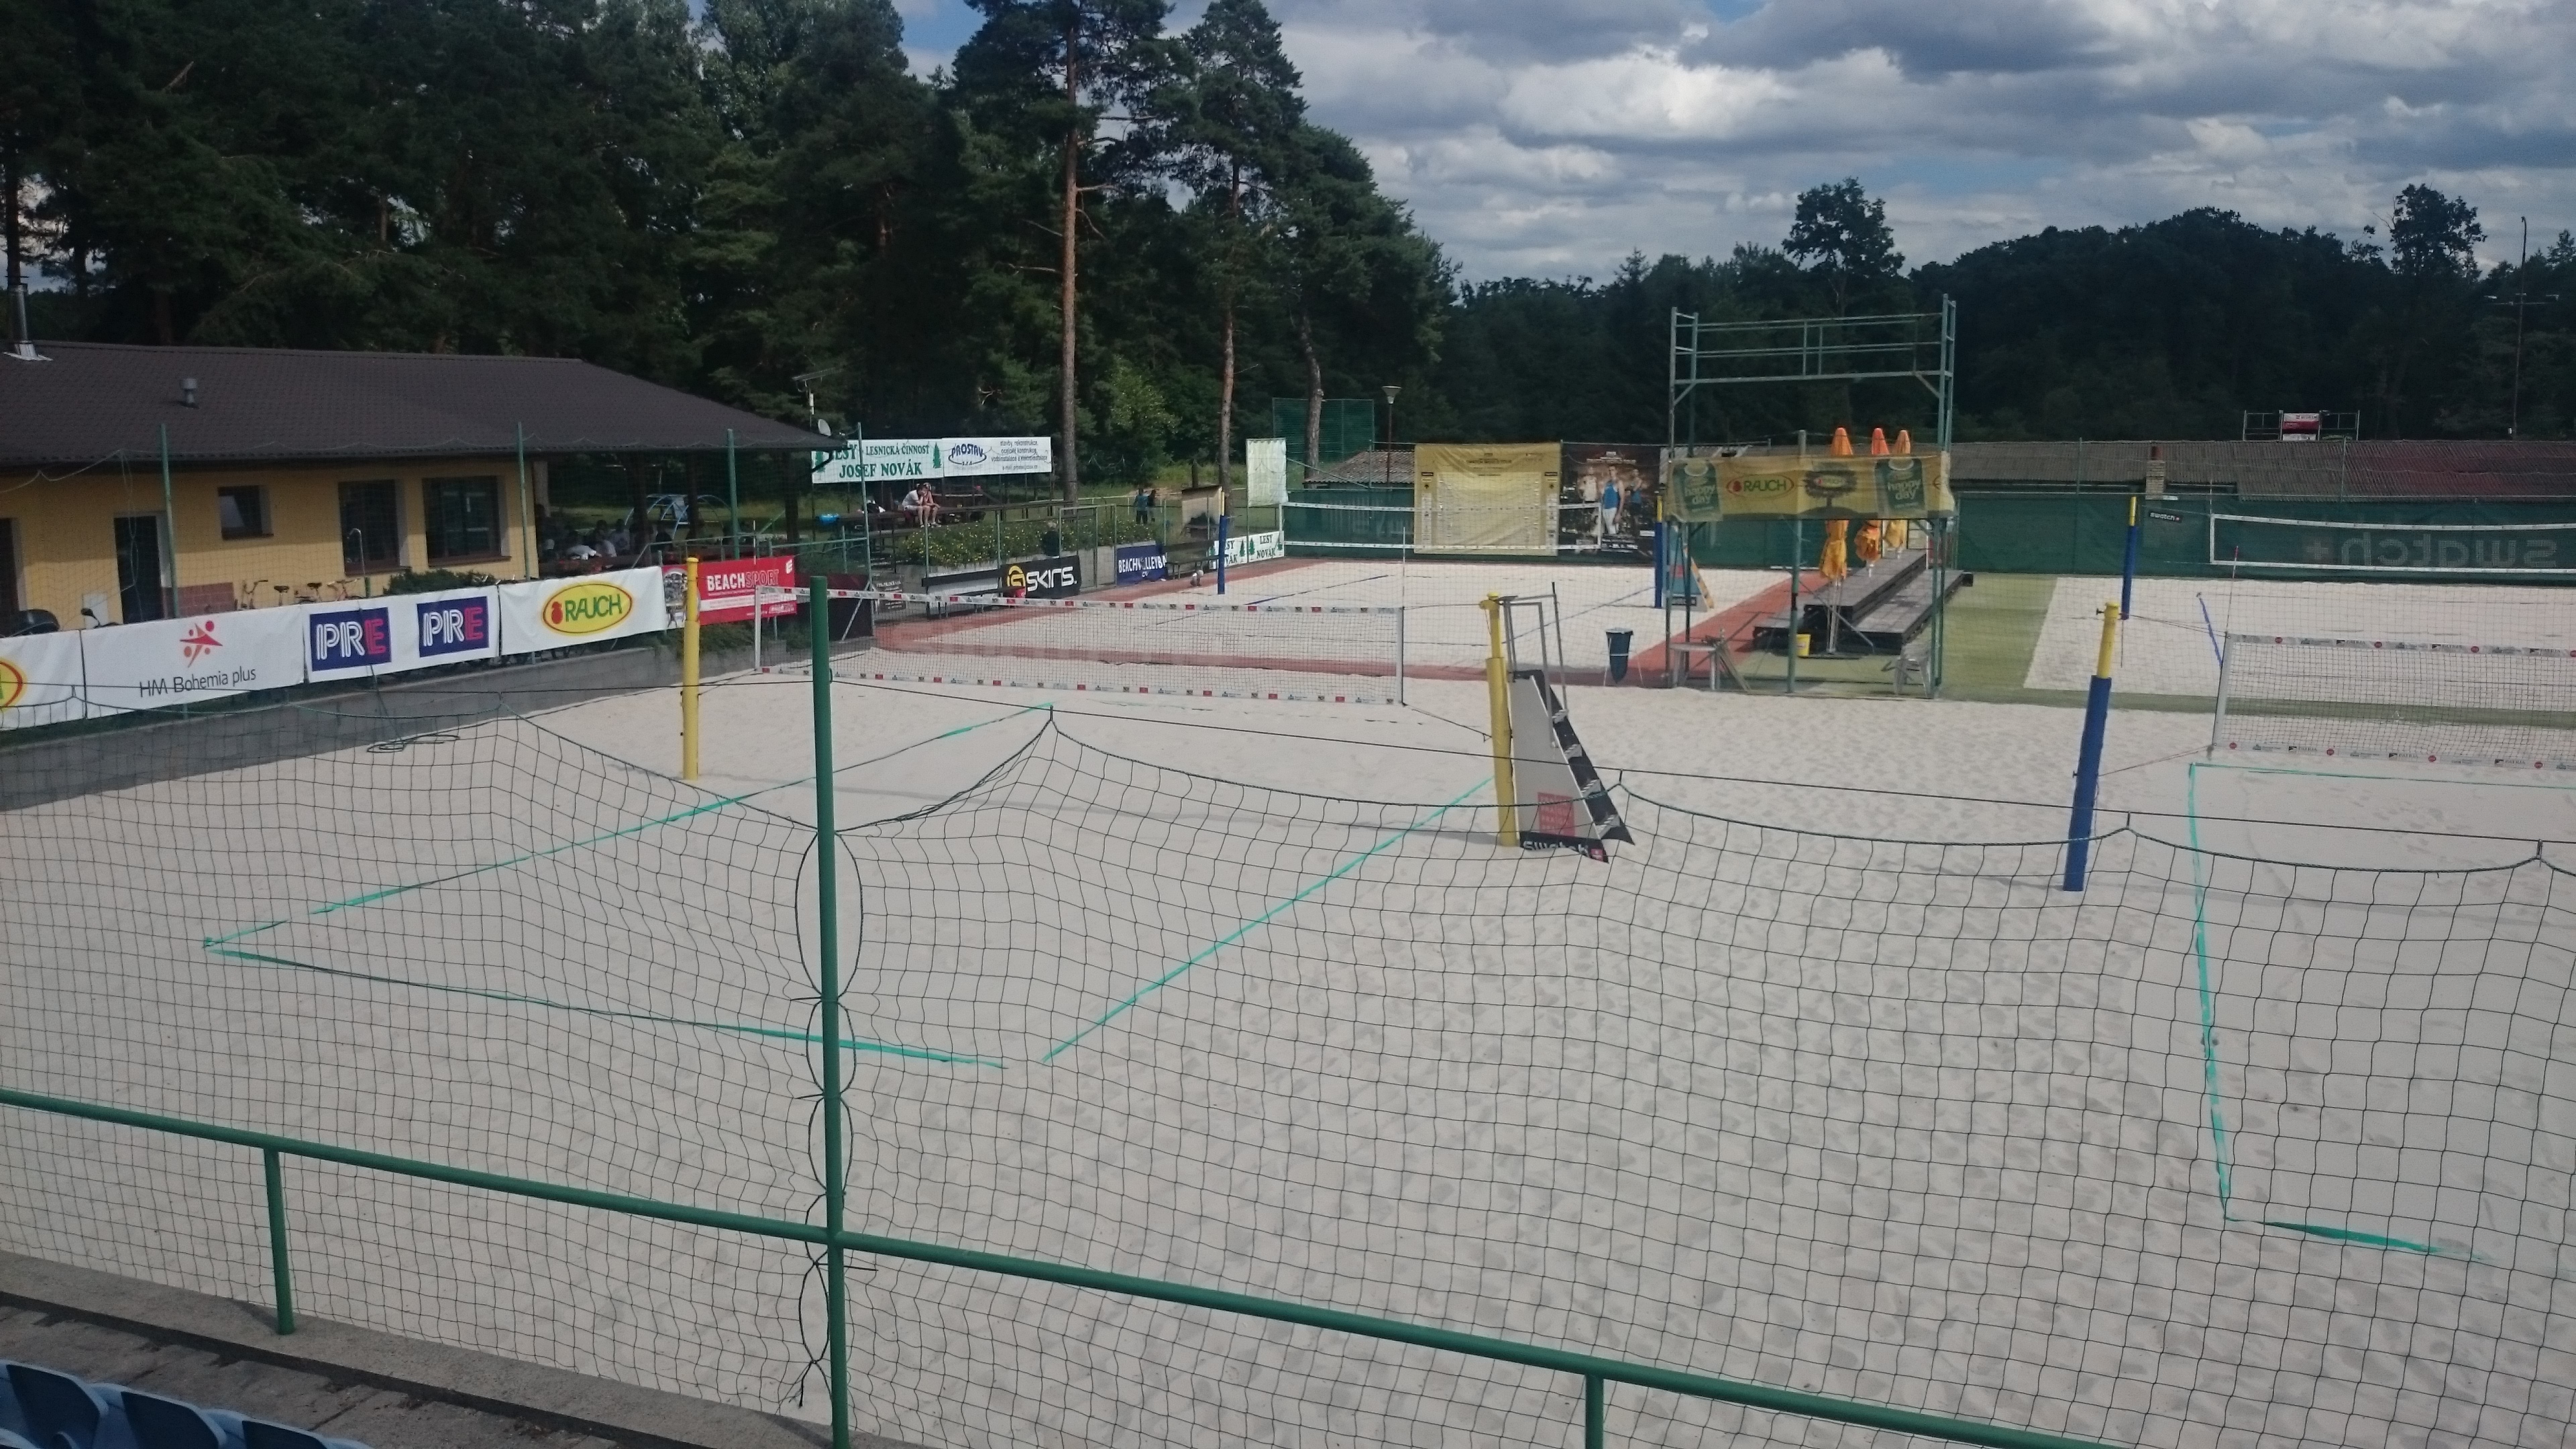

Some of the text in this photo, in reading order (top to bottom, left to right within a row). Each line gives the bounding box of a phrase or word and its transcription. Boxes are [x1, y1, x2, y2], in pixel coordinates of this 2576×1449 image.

[866, 443, 900, 455] LESNICKÁ
[901, 443, 929, 455] ČINNOST
[951, 443, 983, 458] PROSTAV
[839, 459, 922, 478] JOSEF NOVÁK
[1743, 479, 1786, 492] RAUCH
[1260, 534, 1273, 544] LESY
[1256, 546, 1276, 559] NOVÁK
[706, 569, 780, 591] BEACHSPORT
[565, 594, 623, 623] RAUCH
[423, 606, 484, 647] PRE
[316, 619, 386, 660] PRE
[140, 665, 256, 698] HM Bohemia plus
